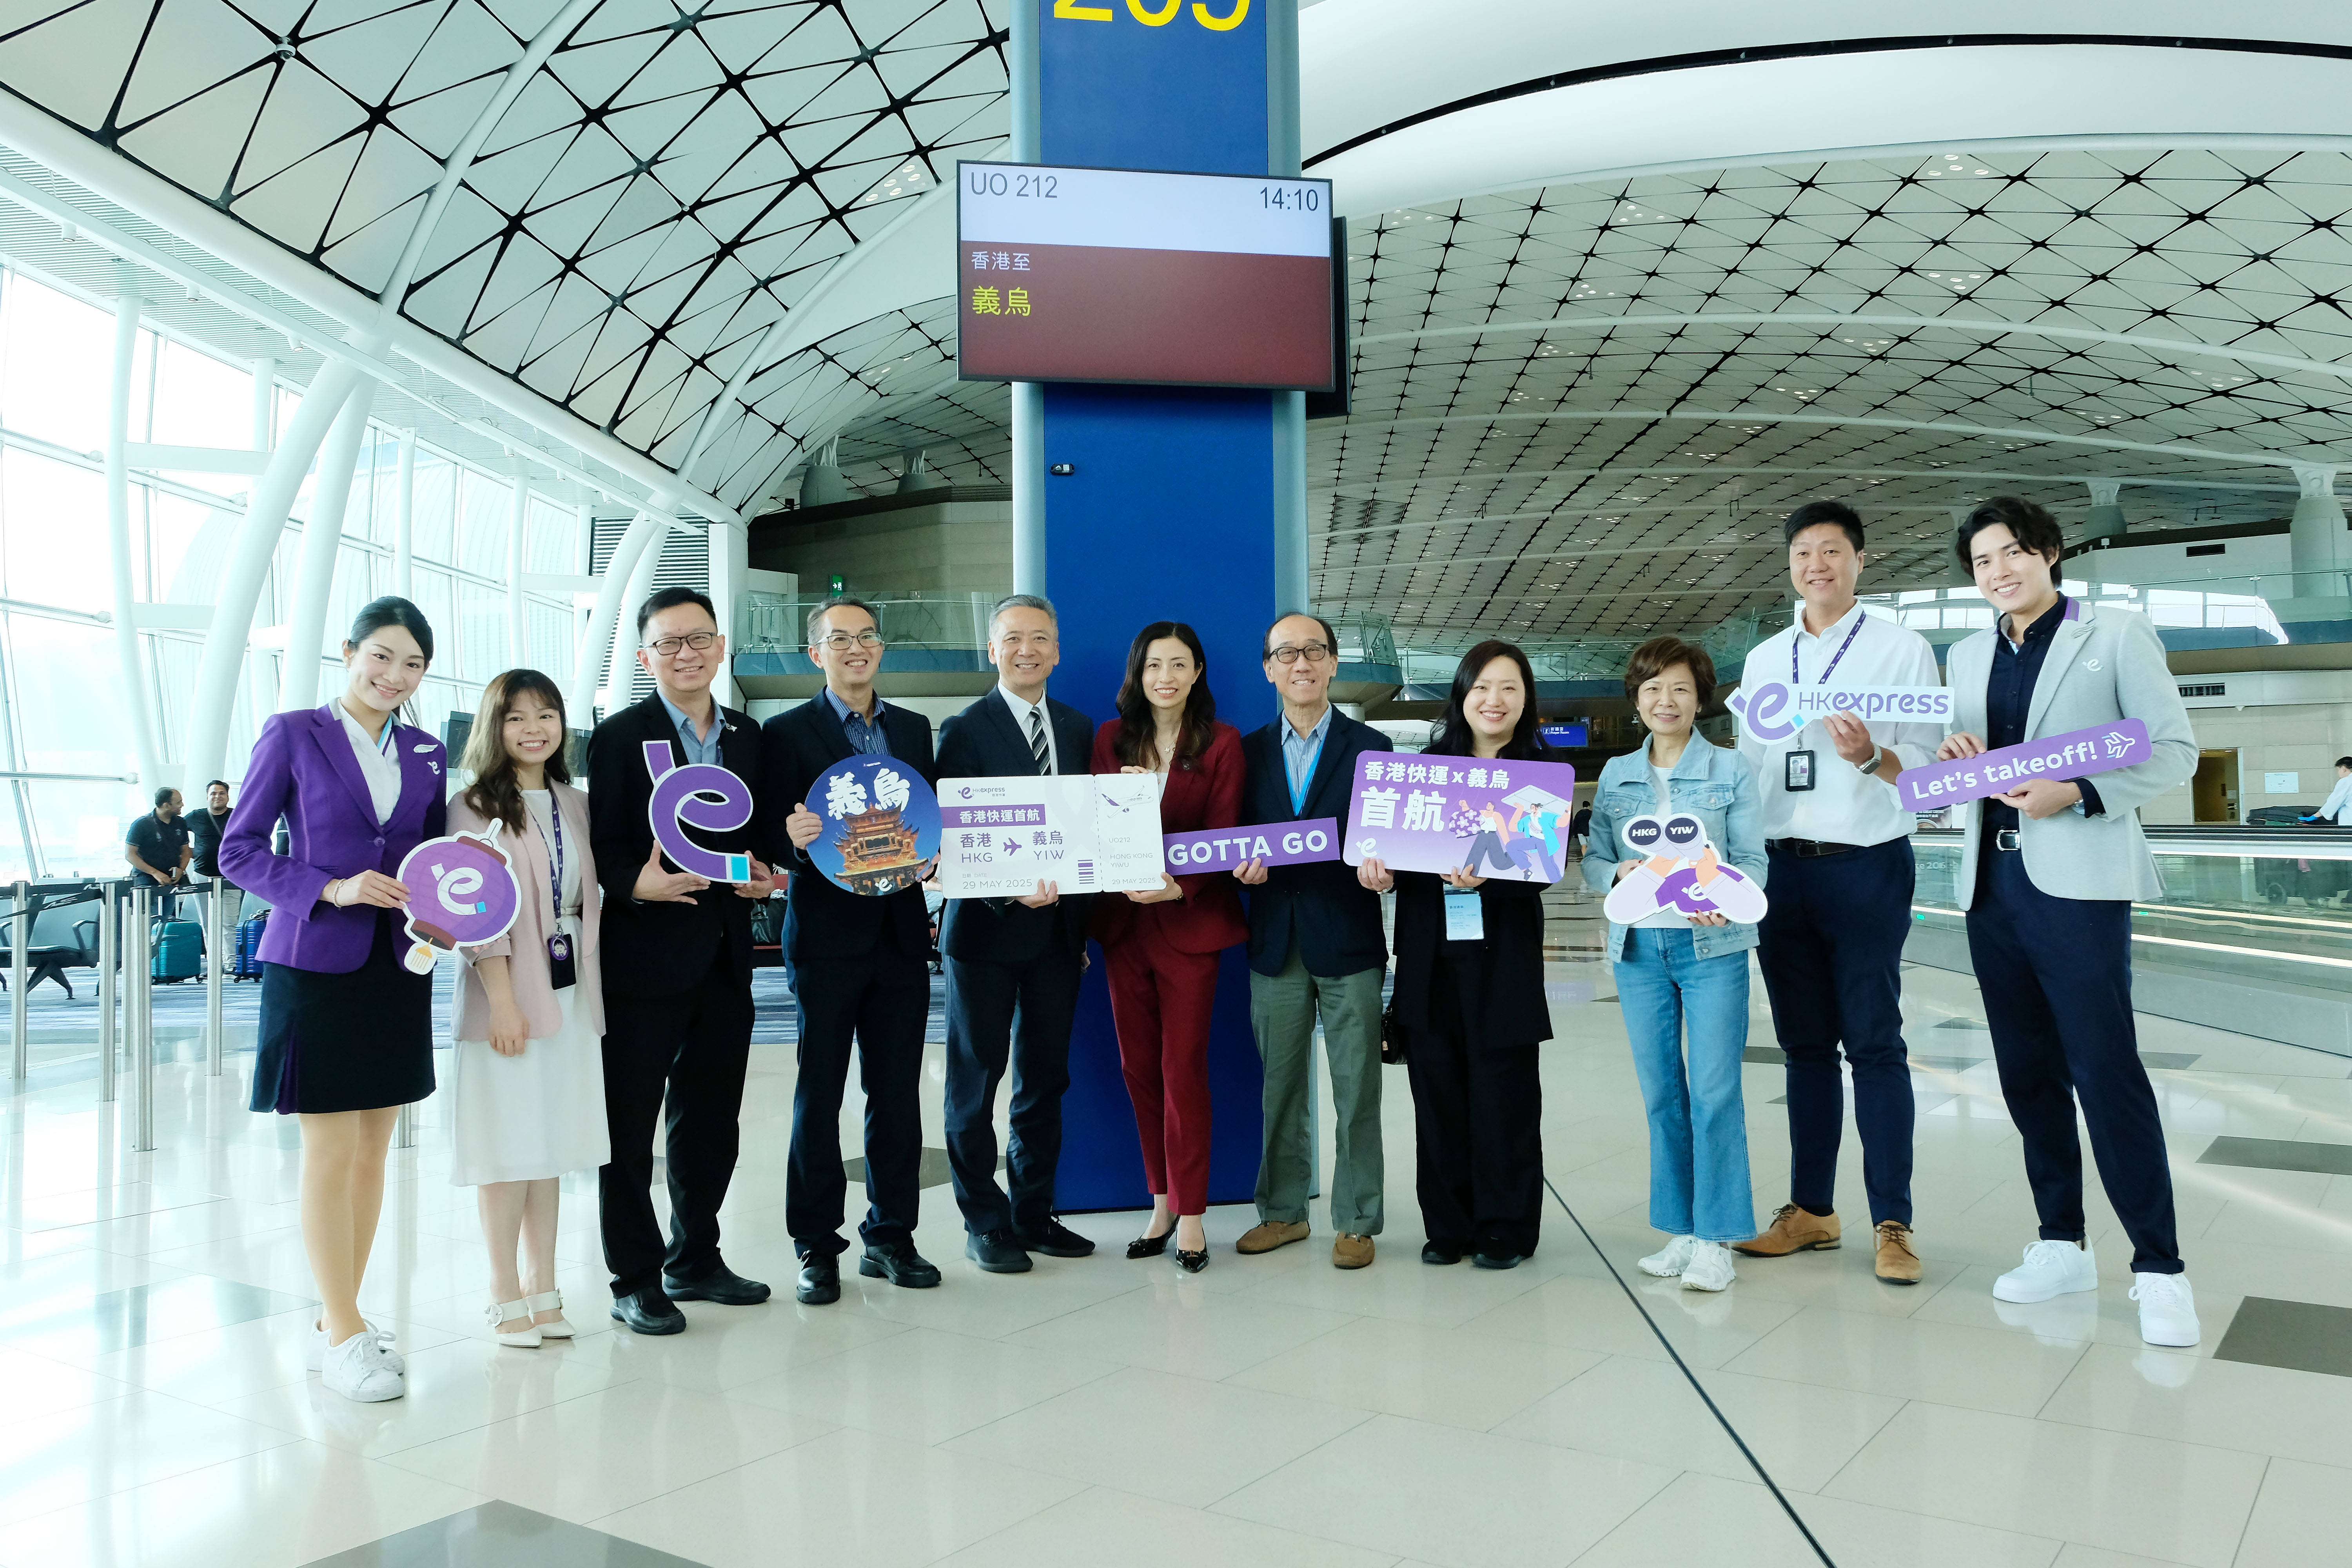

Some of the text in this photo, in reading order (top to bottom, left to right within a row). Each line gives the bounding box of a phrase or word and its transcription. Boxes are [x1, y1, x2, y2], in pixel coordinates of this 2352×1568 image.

[971, 172, 1058, 199] UO 212
[1259, 186, 1318, 212] 14:10
[971, 250, 1031, 272] 香港至
[971, 285, 1031, 317] 義烏
[1798, 691, 1949, 719] HKexpress
[1983, 741, 2098, 782] takeoff!
[826, 768, 910, 820] 義烏
[959, 808, 1040, 824] 香港快運首航
[1360, 786, 1447, 832] 首航
[960, 830, 1063, 848] 香港 義烏
[1632, 826, 1695, 837] HKG YIW
[962, 850, 1064, 863] HKG YIW
[1167, 830, 1328, 866] GOTTA GO
[963, 879, 1033, 889] 29 MAY 2025
